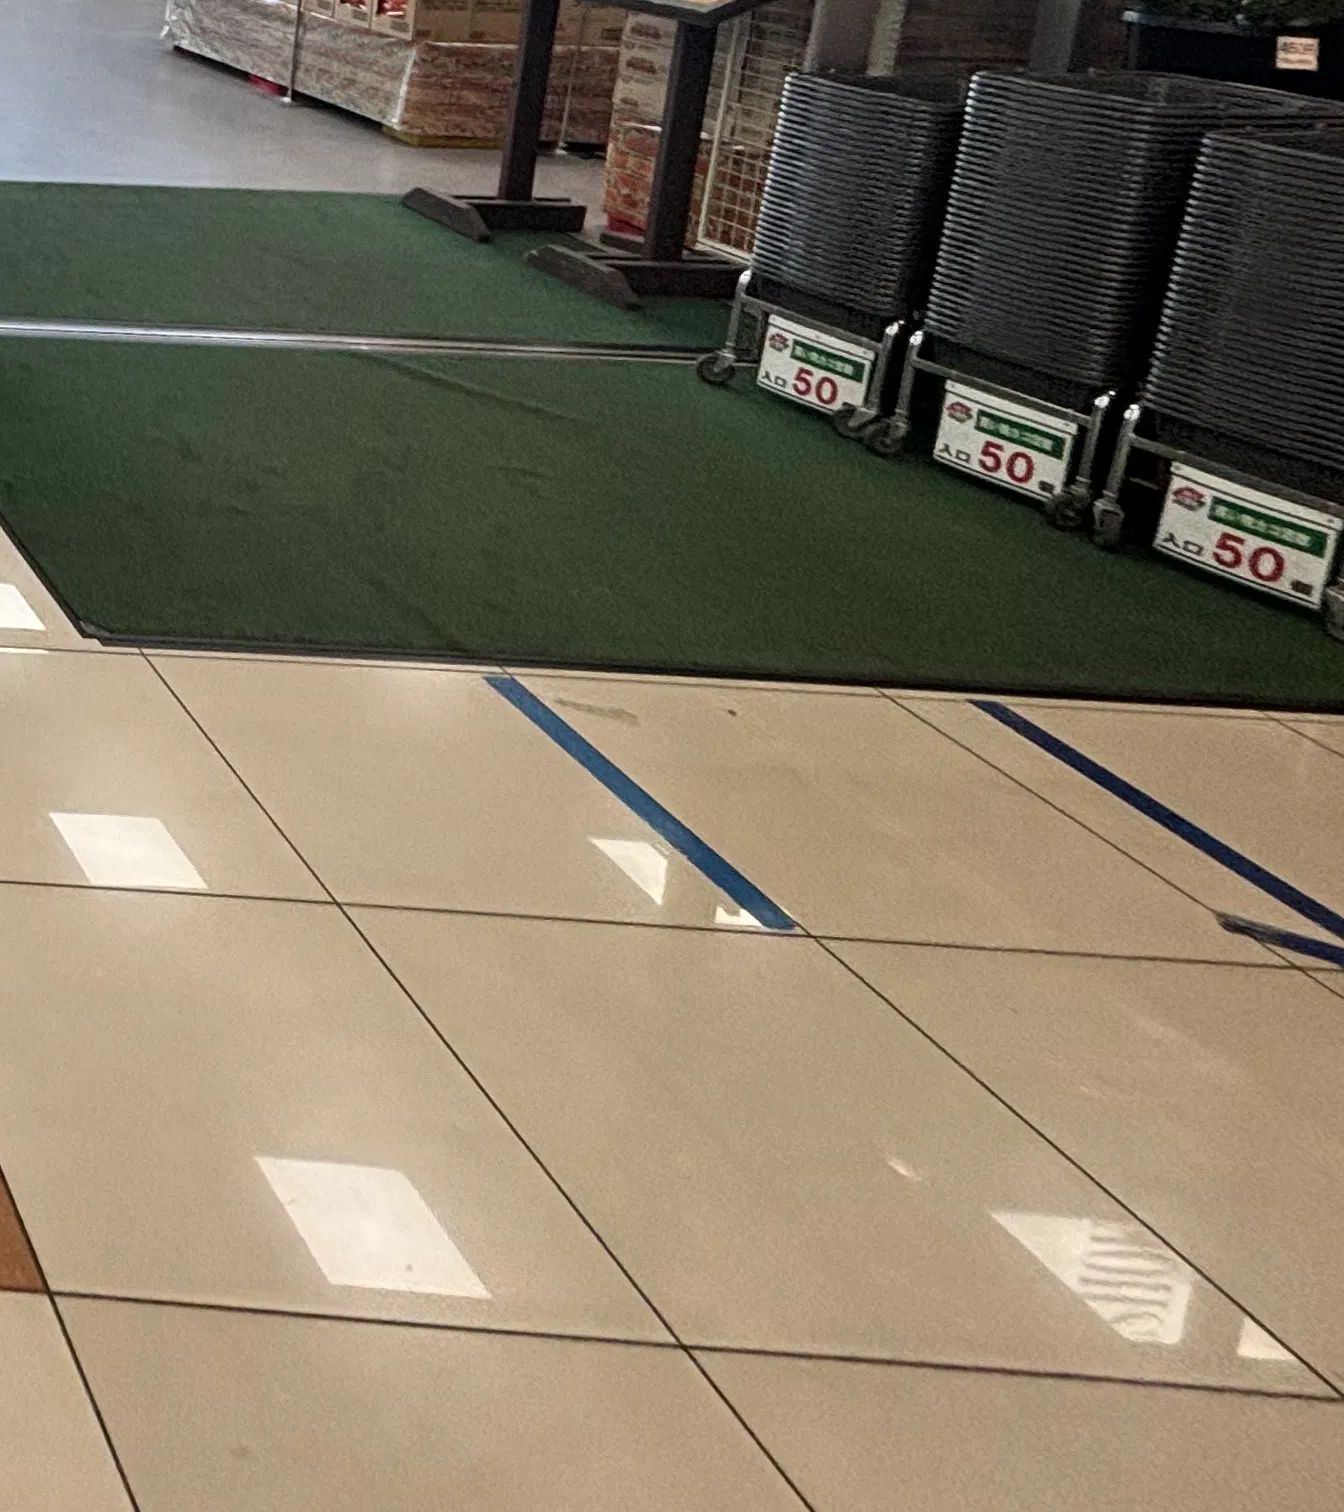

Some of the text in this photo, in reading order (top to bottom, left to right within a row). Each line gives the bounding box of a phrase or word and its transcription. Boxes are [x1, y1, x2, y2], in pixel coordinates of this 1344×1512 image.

[792, 366, 839, 406] 50
[978, 440, 1035, 484] 50
[1213, 531, 1286, 583] 50
